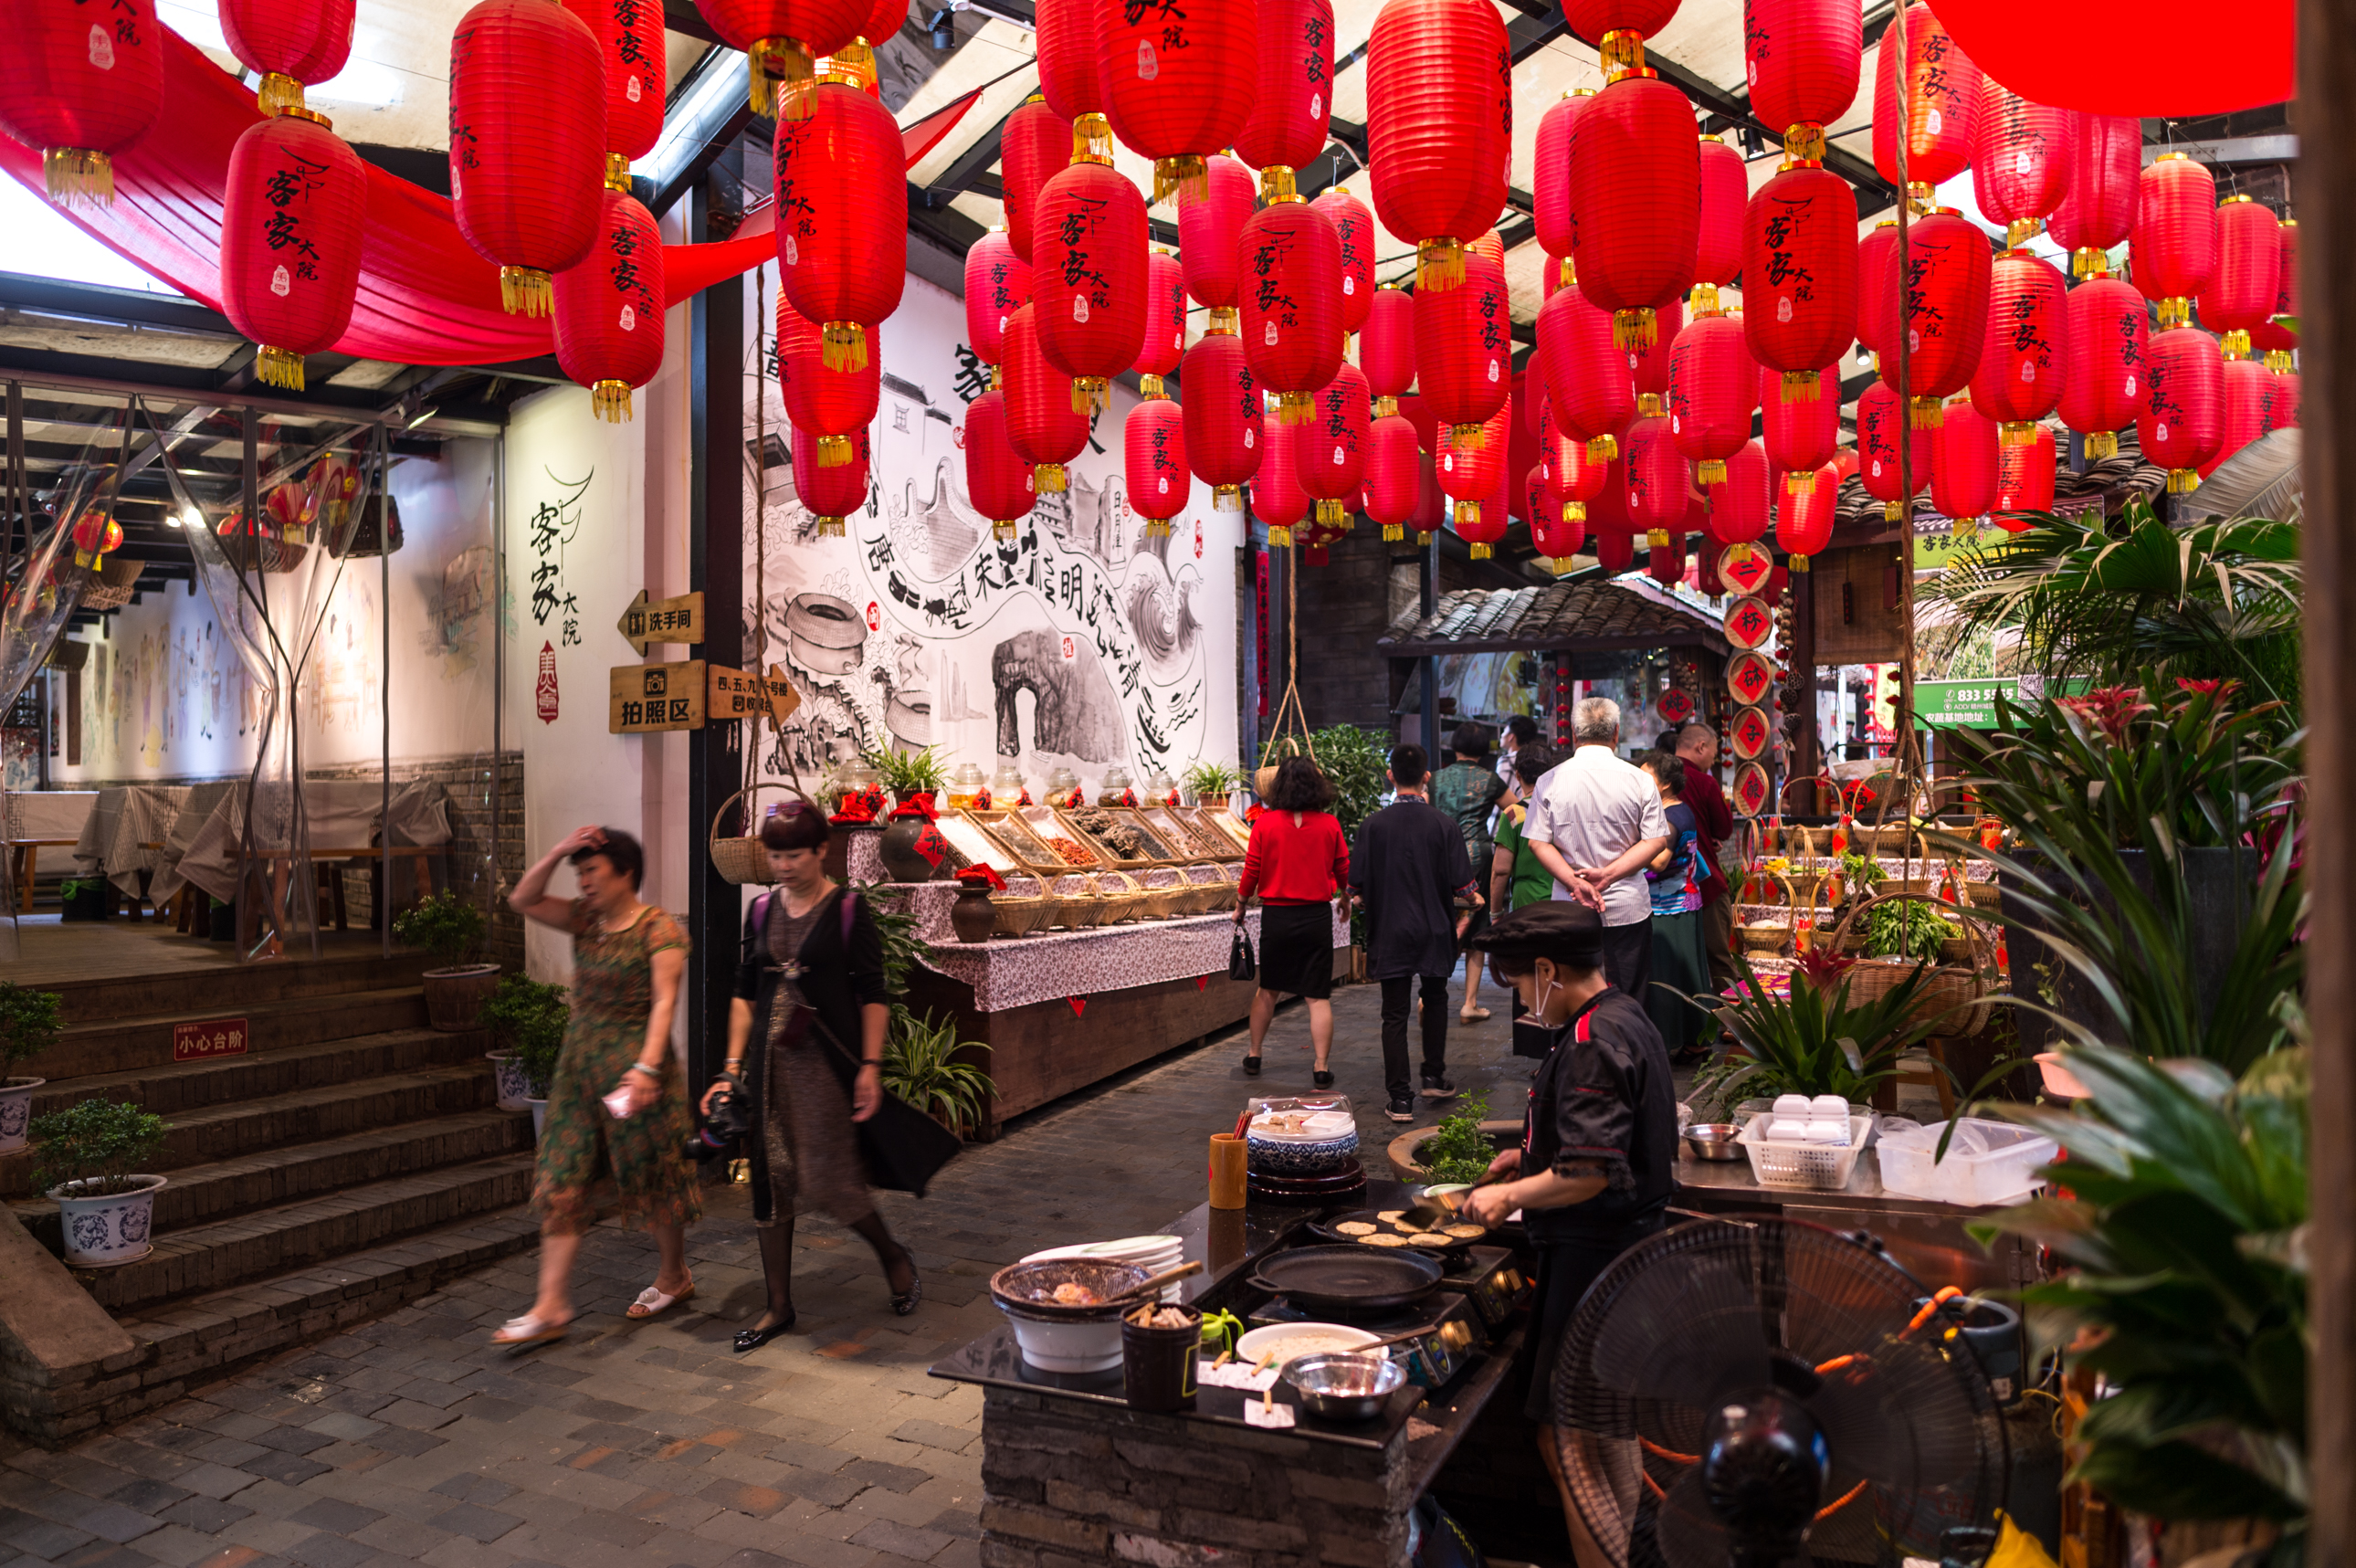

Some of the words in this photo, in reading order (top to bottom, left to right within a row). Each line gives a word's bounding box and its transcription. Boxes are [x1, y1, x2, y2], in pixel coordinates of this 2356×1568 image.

[1920, 35, 1962, 121] 客家大院
[264, 170, 321, 280] 客家大院
[1337, 218, 1367, 284] 客家大院
[610, 226, 654, 321] 客家大院
[1060, 213, 1110, 309] 客家大院
[1764, 216, 1814, 303] 客家大院
[1253, 246, 1299, 330] 客家大院
[2012, 295, 2052, 368] 客家大院
[1326, 390, 1358, 453] 客家大院
[2148, 367, 2183, 427] 客家大院
[1152, 427, 1179, 483] 客家大院
[1866, 413, 1895, 465] 客家大院
[862, 533, 895, 572] 唐
[1923, 534, 1980, 552] 客家大院
[531, 501, 582, 647] 客家大院
[975, 552, 1004, 602] 宋
[1061, 563, 1082, 621] 明
[648, 609, 691, 632] 洗手间
[1741, 611, 1762, 633] 杯
[1119, 644, 1141, 699] 清
[1957, 689, 1981, 702] 833
[622, 699, 690, 726] 拍照区
[1666, 694, 1688, 713] 炖
[1746, 724, 1761, 742] 子
[1846, 786, 1867, 805] 福
[925, 831, 947, 856] 福
[179, 1029, 244, 1054] 小心台阶
